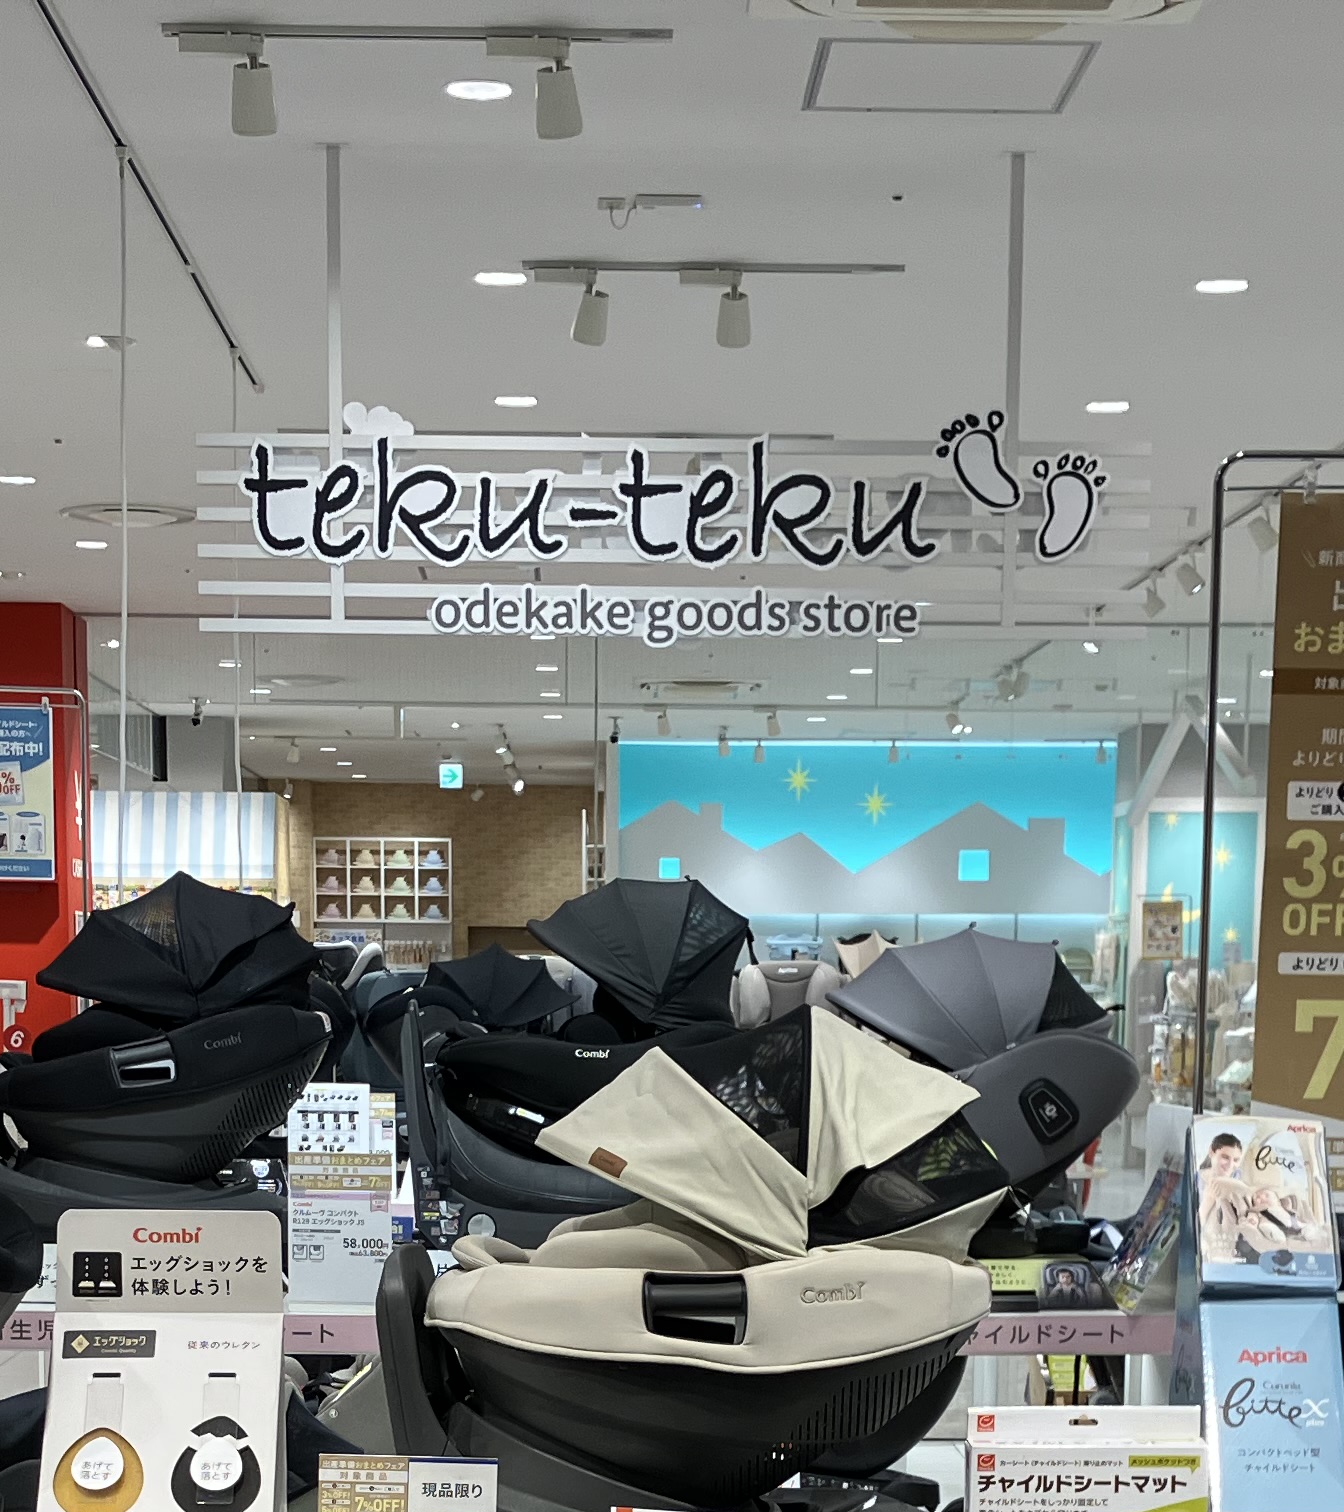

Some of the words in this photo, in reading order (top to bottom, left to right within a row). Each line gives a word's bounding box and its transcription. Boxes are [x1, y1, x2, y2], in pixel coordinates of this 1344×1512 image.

[244, 437, 936, 565] teku-teku
[437, 586, 634, 633] odekake
[649, 587, 787, 646] goods
[803, 593, 918, 633] store
[2, 784, 22, 795] OFF
[204, 1032, 242, 1050] Combi
[574, 1049, 610, 1059] Combi
[1286, 1124, 1317, 1134] Aprica
[132, 1226, 203, 1244] Combi
[342, 1238, 389, 1250] 58,000円
[130, 1256, 268, 1273] エッグショックを
[131, 1279, 232, 1296] 体験しよう!
[800, 1280, 866, 1304] Combi
[93, 1335, 146, 1347] エッグショック
[187, 1340, 261, 1350] 従来のウレタン
[1237, 1346, 1308, 1368] Aprica
[81, 1460, 114, 1470] あげて
[201, 1461, 233, 1471] あげて
[322, 1460, 406, 1471] 出産準備おまとめフェア
[79, 1470, 112, 1480] 落とす
[200, 1471, 232, 1481] 落とす
[421, 1481, 484, 1499] 現品限り
[977, 1474, 1188, 1494] チャイルドシートマット
[978, 1498, 1109, 1507] チャイルドシートをしっかり固定して
